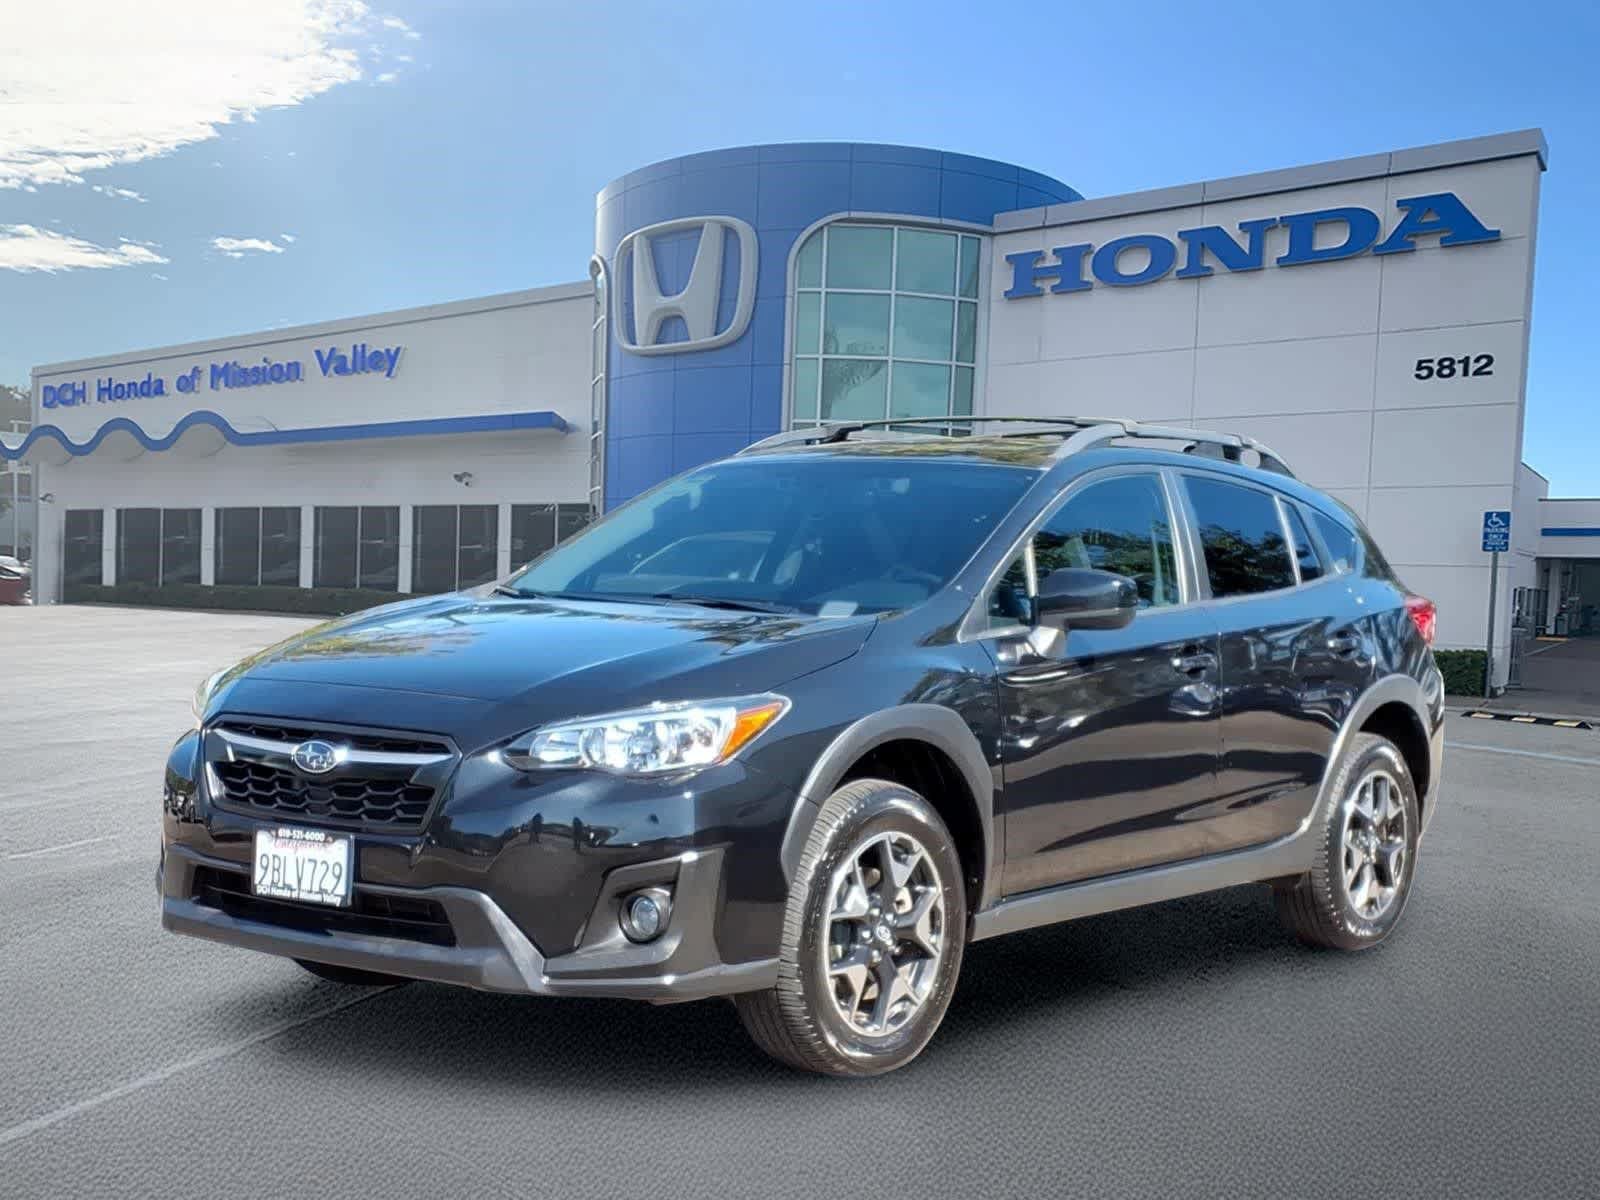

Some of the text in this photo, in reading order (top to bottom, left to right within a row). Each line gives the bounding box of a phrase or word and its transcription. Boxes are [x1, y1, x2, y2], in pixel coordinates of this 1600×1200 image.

[1003, 192, 1501, 300] HONDA
[42, 344, 402, 408] DCH Honda of Mission Valley
[1414, 354, 1494, 381] 5812
[259, 853, 342, 894] 9BLV729
